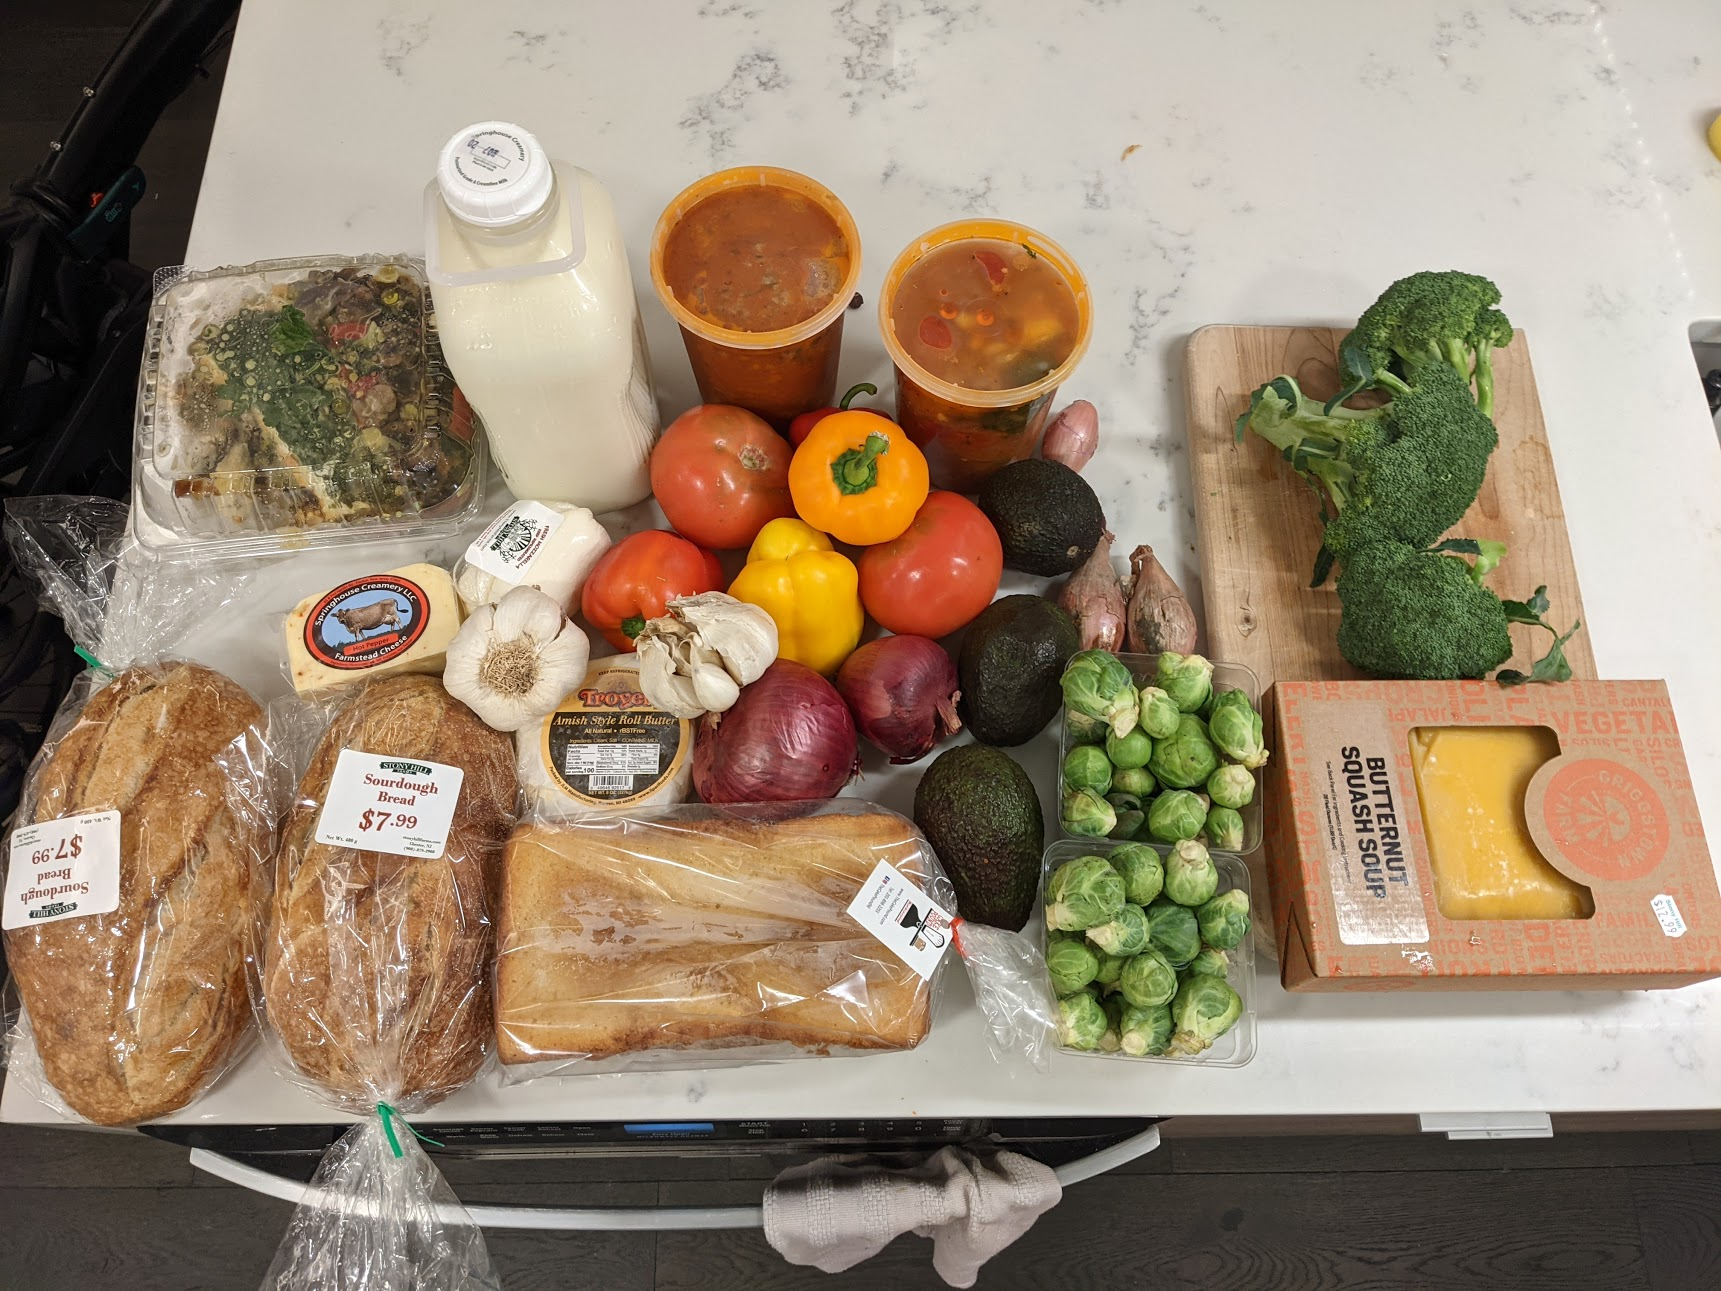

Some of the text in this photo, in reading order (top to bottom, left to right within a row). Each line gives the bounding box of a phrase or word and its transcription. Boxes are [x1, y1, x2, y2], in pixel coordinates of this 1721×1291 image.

[512, 138, 525, 161] Creamery
[516, 526, 550, 569] FRESH MOZZARELLA
[315, 587, 360, 626] Springhouse
[361, 583, 404, 593] Creamery
[402, 588, 418, 603] LLC
[334, 651, 378, 662] Farmstead
[380, 635, 408, 656] Cheese
[352, 638, 390, 652] Hot Pepper
[554, 715, 678, 728] Amish Style Roll Butter
[410, 764, 429, 774] HILL
[363, 773, 439, 796] Sourdough
[377, 791, 416, 806] Bread
[358, 808, 418, 832] $7.99
[1341, 746, 1387, 899] SQUASH SOUP
[1366, 757, 1409, 886] BUTTERNUT
[1556, 791, 1581, 846] FARM
[1598, 769, 1658, 869] GRIGGSTOWN
[32, 834, 83, 864] $7.99
[38, 868, 72, 884] Bread
[21, 882, 89, 905] Sourdough
[32, 904, 74, 917] STONY HILL
[1652, 900, 1678, 934] $12.99
[1665, 899, 1683, 930] Stony Hill
